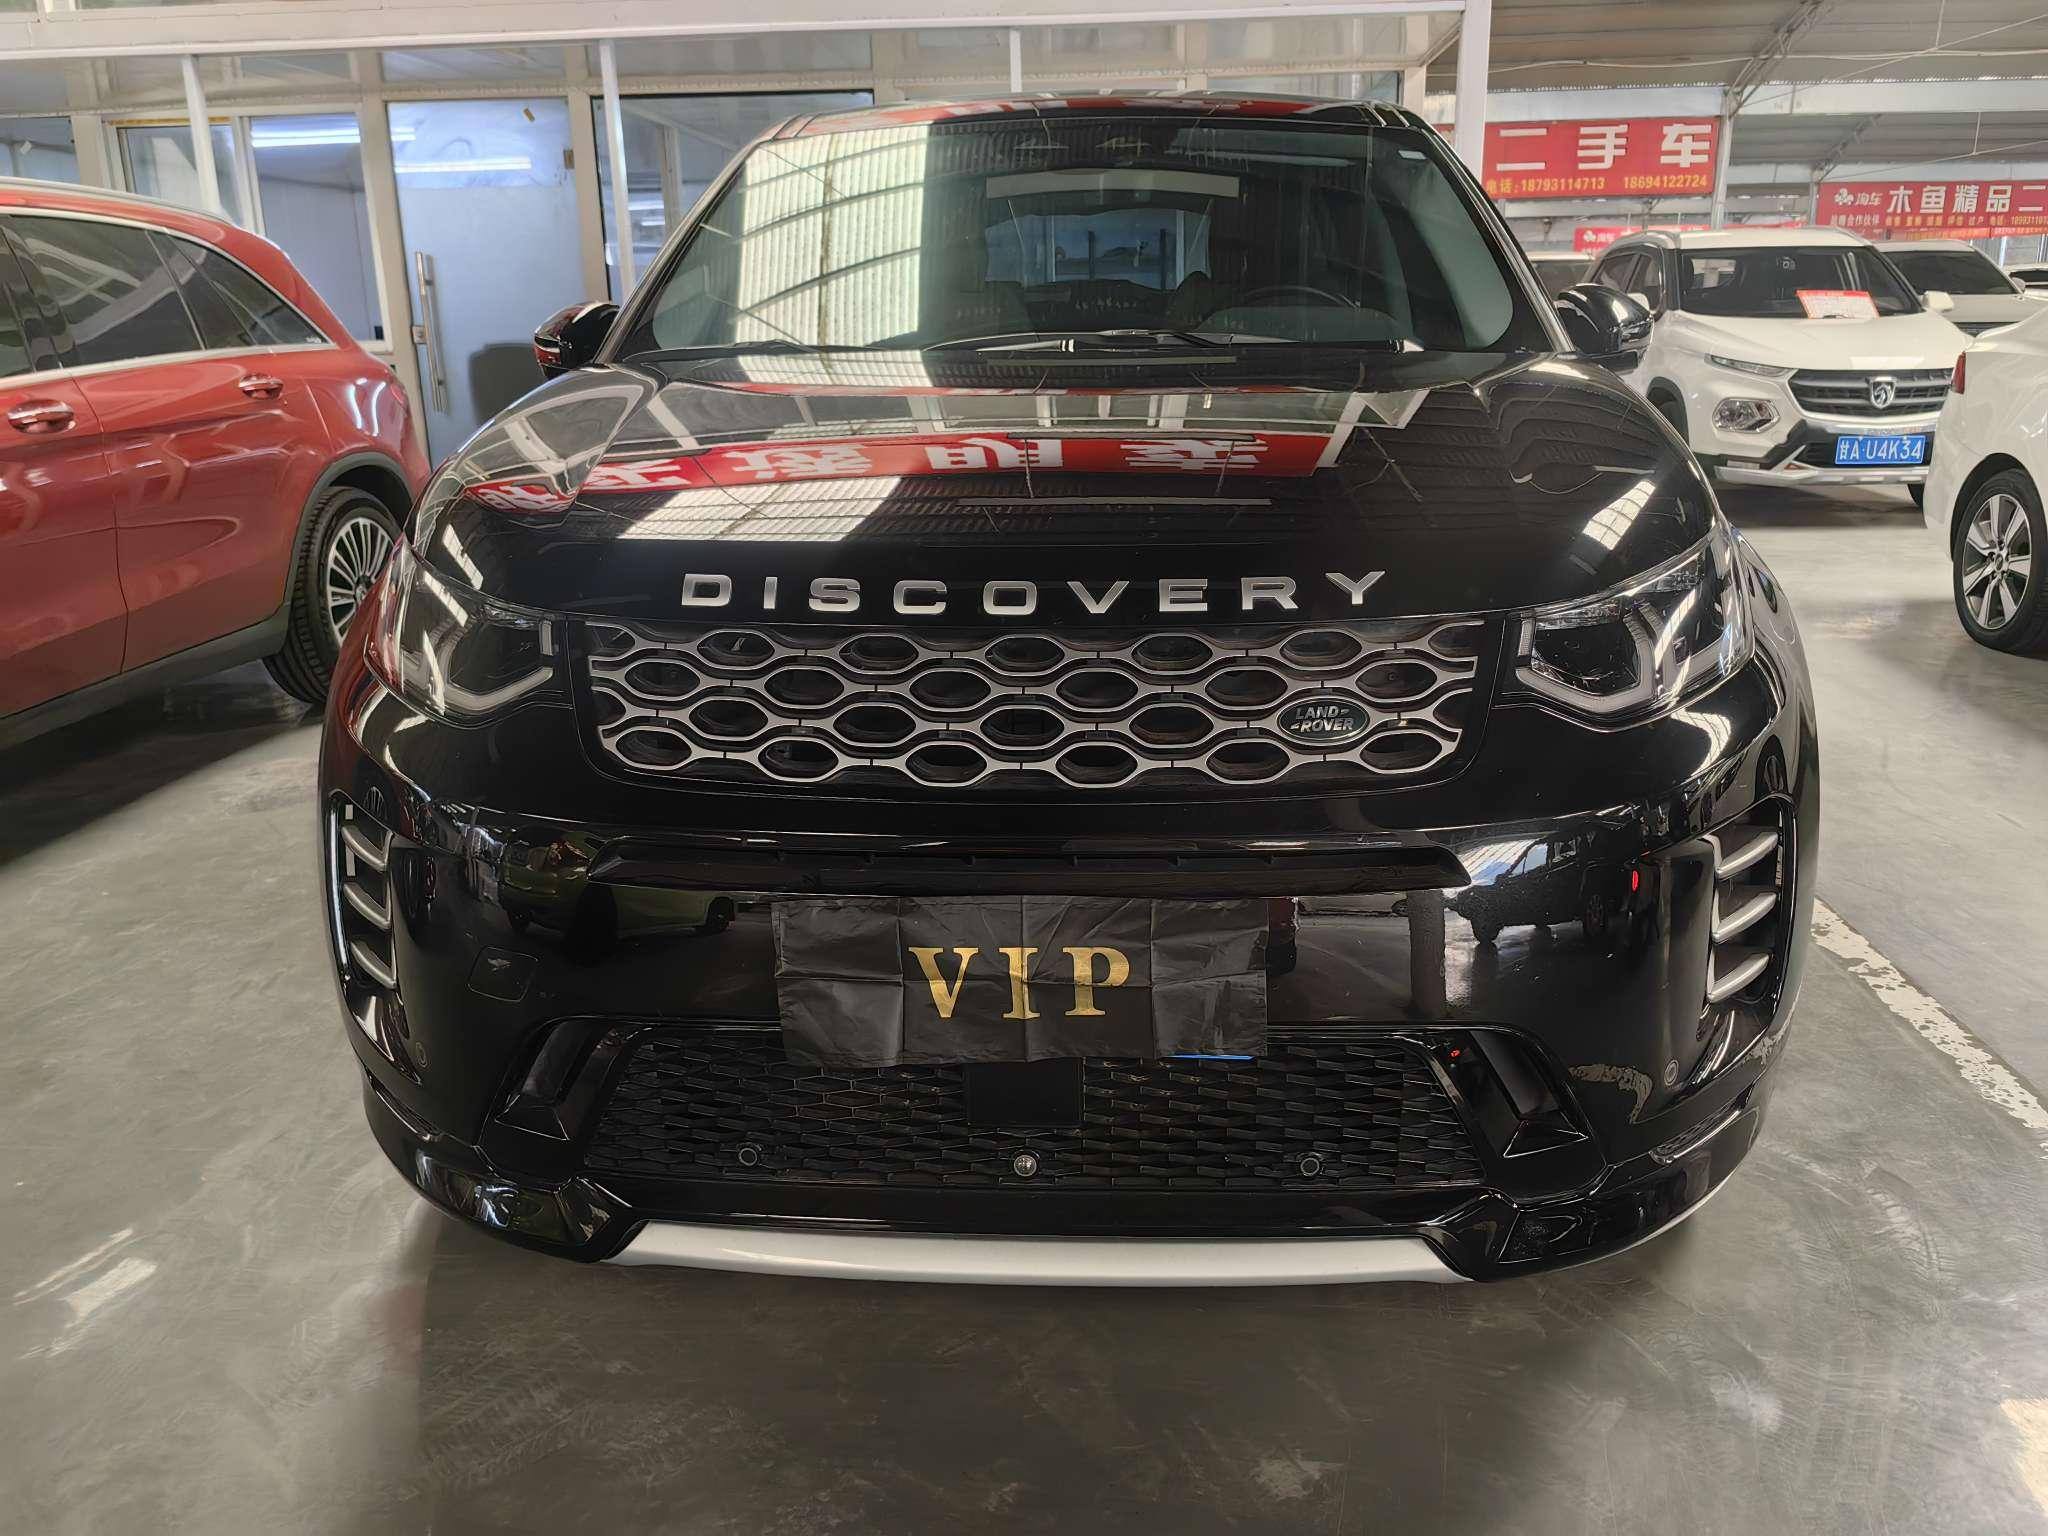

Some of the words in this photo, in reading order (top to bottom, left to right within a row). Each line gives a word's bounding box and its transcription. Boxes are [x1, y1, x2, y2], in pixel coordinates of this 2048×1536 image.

[1496, 123, 1712, 171] 二手车
[1624, 174, 1708, 190] 18694122724
[1886, 184, 2047, 214] 木鱼精品二
[681, 570, 1386, 615] DISCOVERY
[1295, 705, 1340, 720] LAND
[1300, 717, 1354, 733] ROVER
[907, 946, 1131, 1020] VIP
